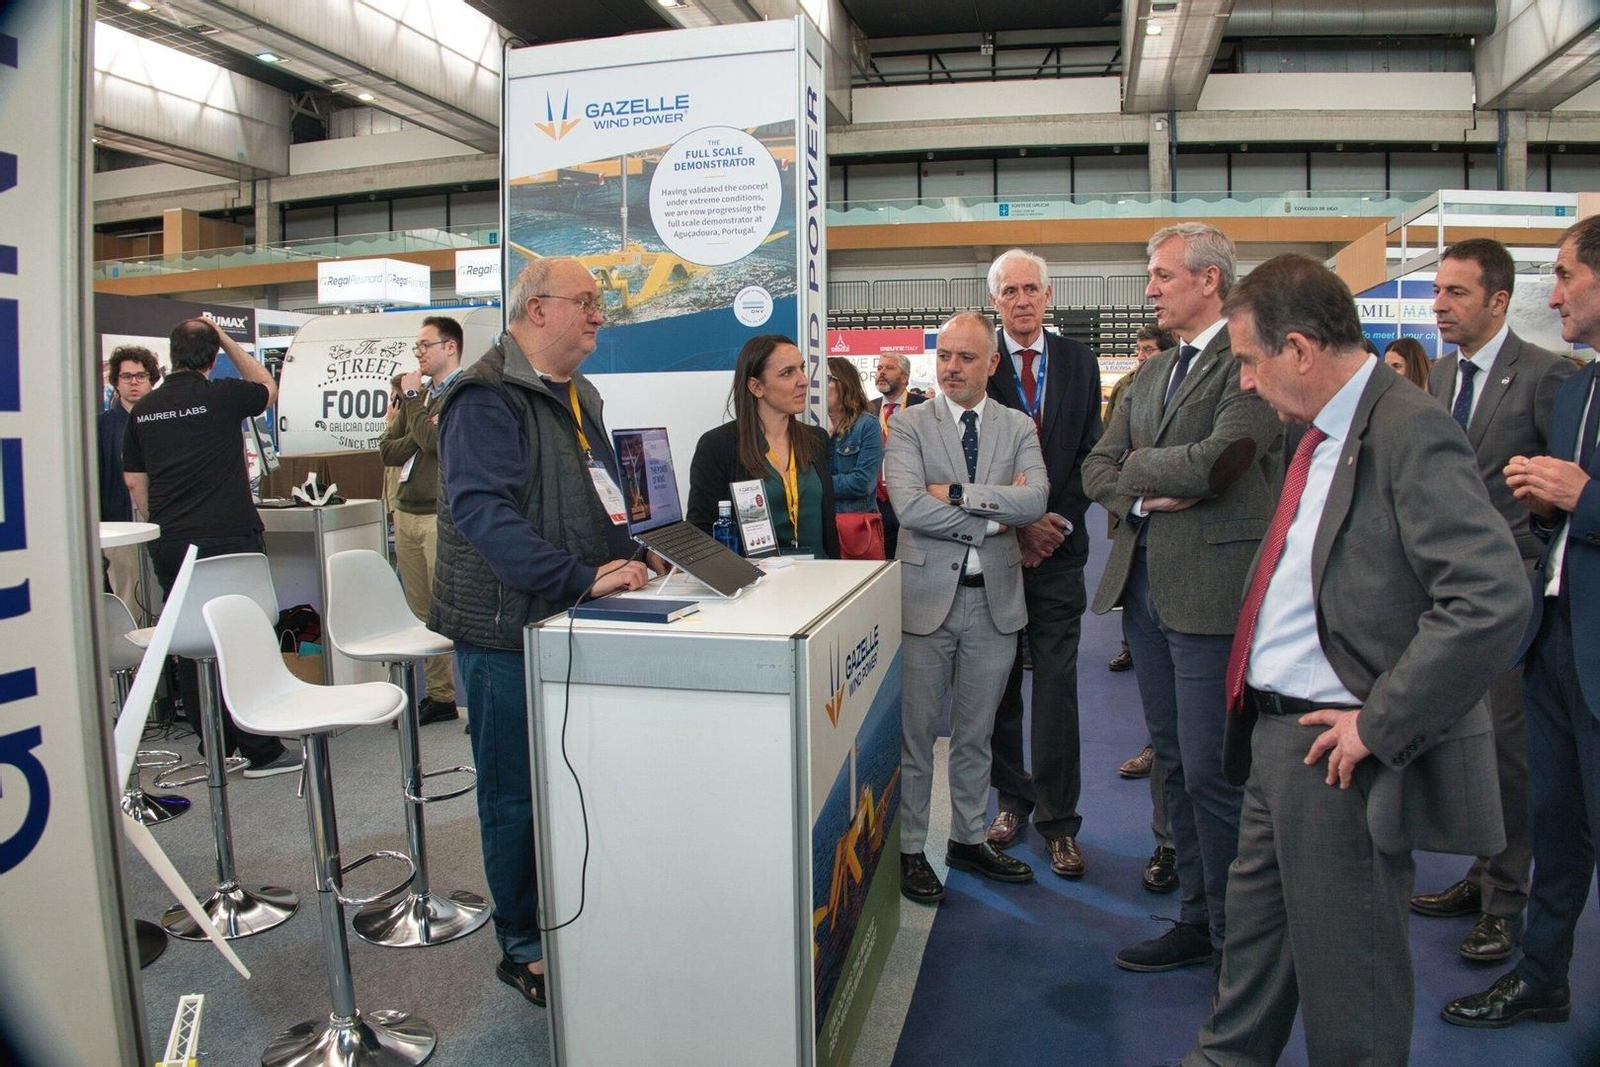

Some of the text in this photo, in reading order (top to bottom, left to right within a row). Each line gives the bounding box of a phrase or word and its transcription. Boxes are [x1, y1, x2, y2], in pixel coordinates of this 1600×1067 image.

[585, 94, 690, 118] GAZELLE
[593, 113, 684, 130] WIND POWER
[685, 146, 743, 159] FULL SCALE
[674, 157, 755, 171] DEMONSTRATOR
[661, 182, 769, 196] Having validated the concept
[807, 86, 819, 292] POWER
[666, 193, 764, 206] under extreme conditions,
[676, 209, 689, 217] are
[707, 205, 752, 216] progressing
[753, 204, 766, 212] the
[667, 215, 763, 227] full scale demonstrator at
[673, 225, 757, 240] Aguçadoura, Portugal.
[1356, 304, 1396, 318] MIL
[1372, 331, 1396, 339] meet
[354, 340, 382, 355] The
[326, 358, 402, 379] STREET
[322, 389, 389, 419] FOOD
[136, 405, 208, 424] MAURER LABS
[329, 422, 363, 432] GALICIAN
[339, 436, 366, 449] SINCE
[845, 624, 879, 680] GAZELLE
[849, 652, 877, 697] WIND POWER
